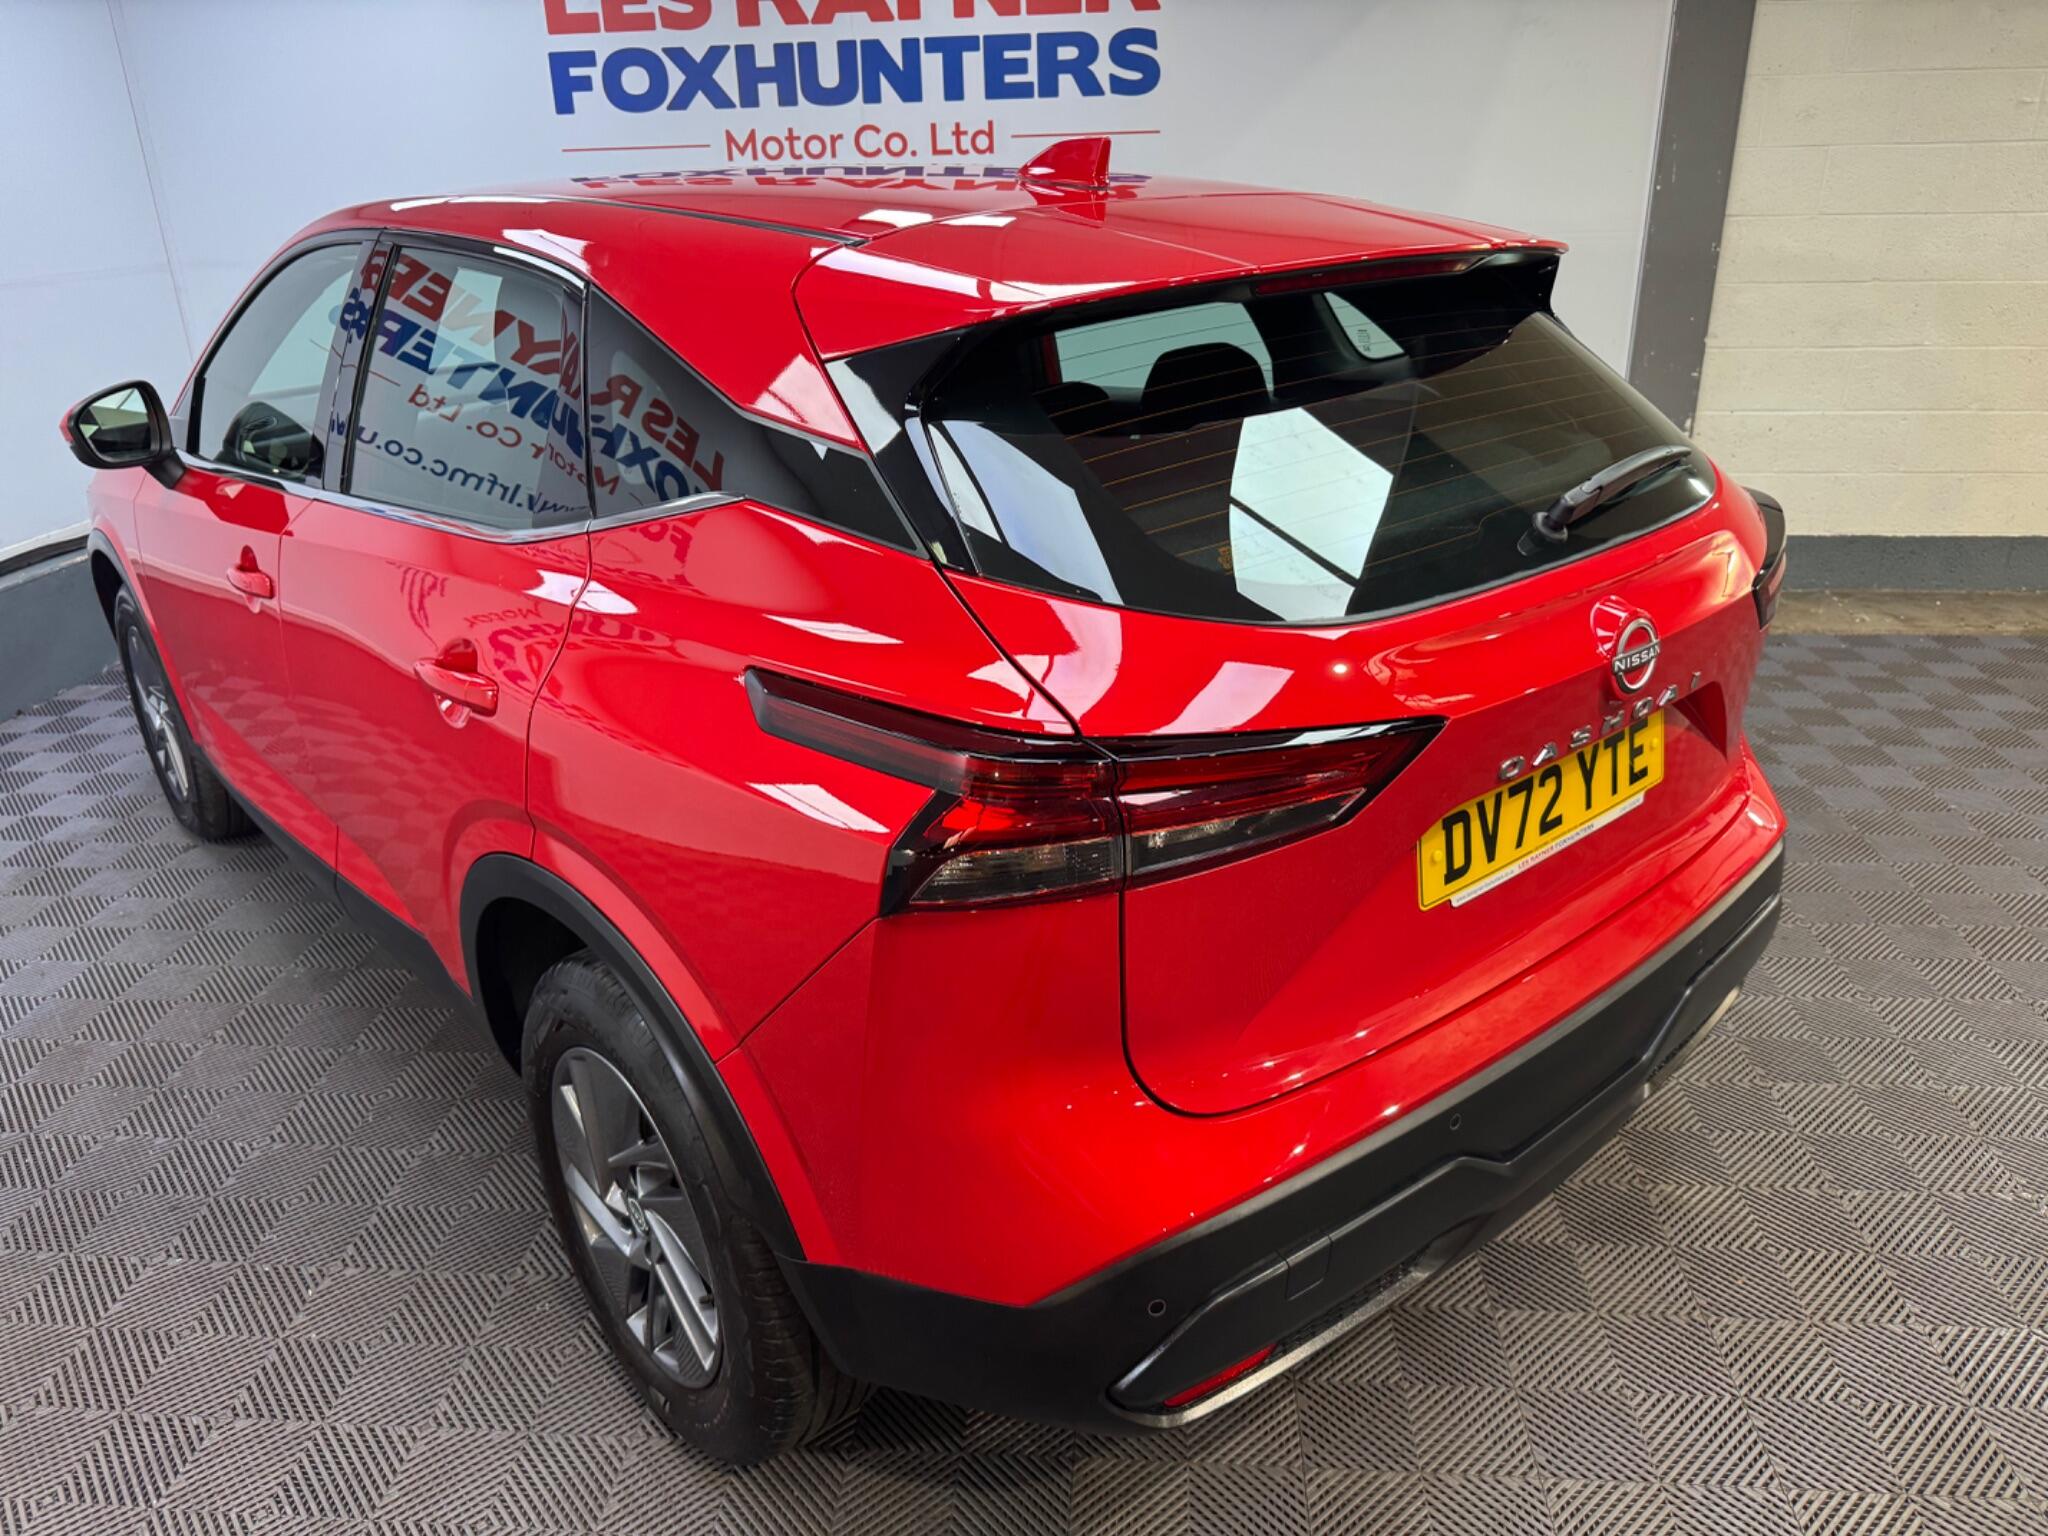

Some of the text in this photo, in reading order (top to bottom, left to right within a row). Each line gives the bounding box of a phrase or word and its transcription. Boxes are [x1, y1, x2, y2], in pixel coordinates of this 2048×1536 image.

[548, 28, 1161, 115] FOXHUNTERS
[724, 120, 996, 161] Motor Co. Ltd
[1613, 643, 1661, 674] NISSAN
[1497, 671, 1702, 781] QASHQAI
[1441, 717, 1650, 886] DV72 YTE
